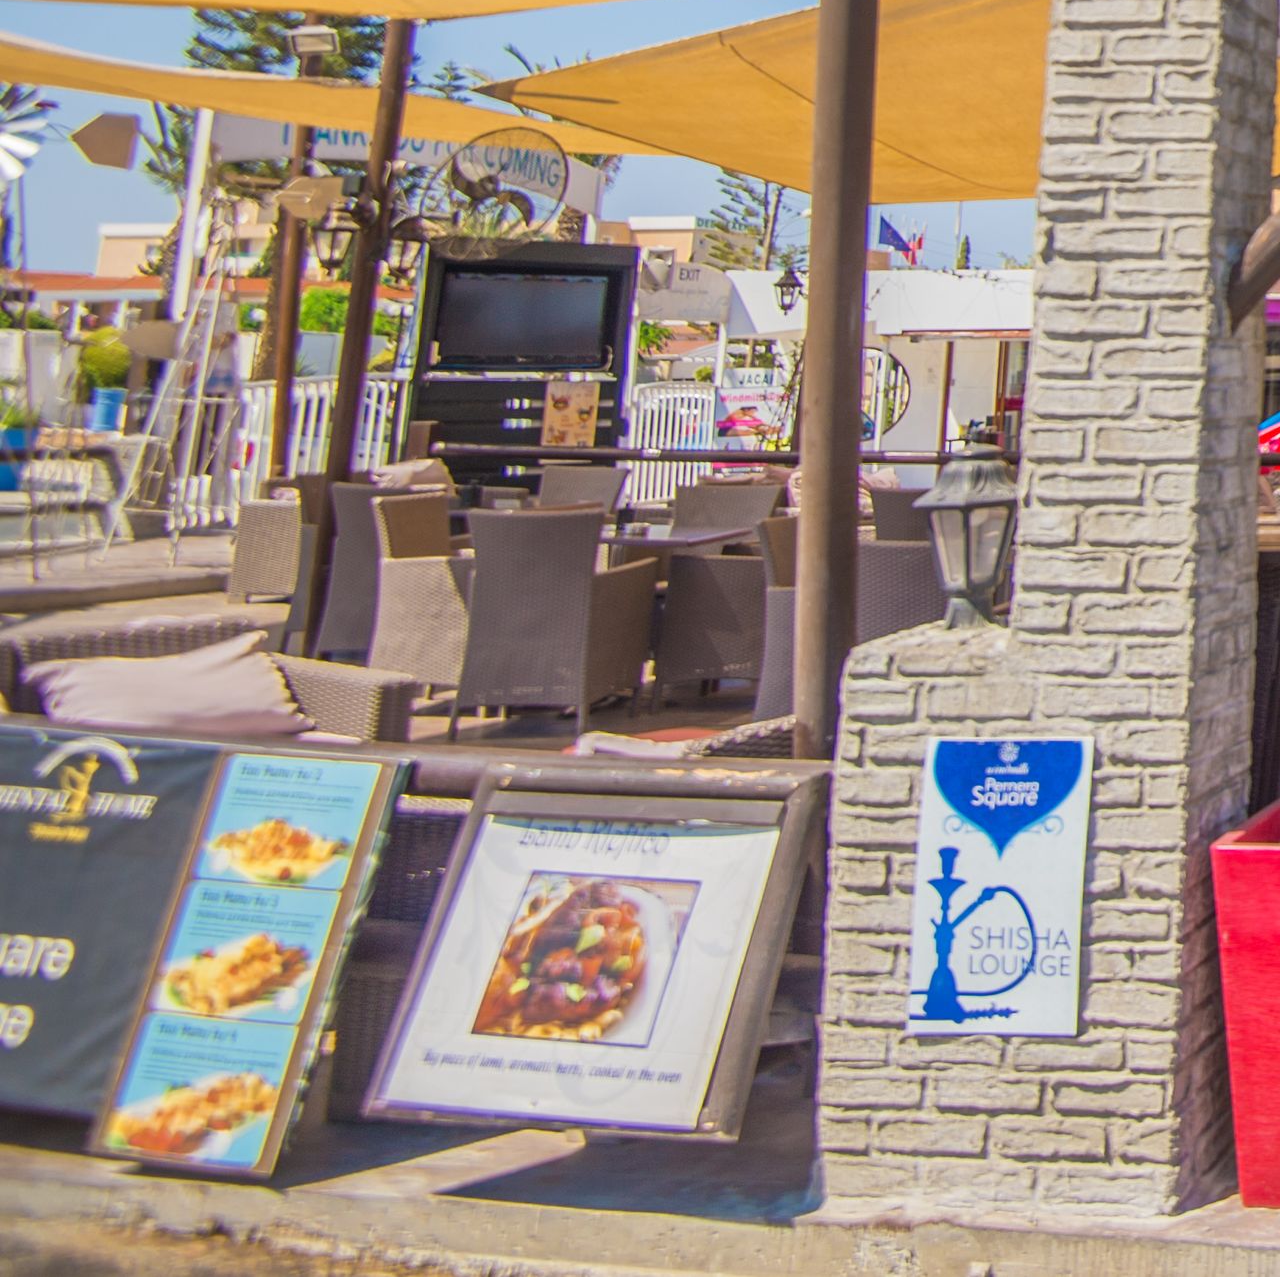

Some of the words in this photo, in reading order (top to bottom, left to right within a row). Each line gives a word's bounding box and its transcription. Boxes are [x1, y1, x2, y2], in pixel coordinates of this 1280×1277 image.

[484, 144, 561, 187] COMING
[679, 268, 701, 281] EXIT
[971, 785, 1039, 810] Square
[970, 926, 1072, 952] SHISHA
[968, 953, 1071, 977] LOUNGE
